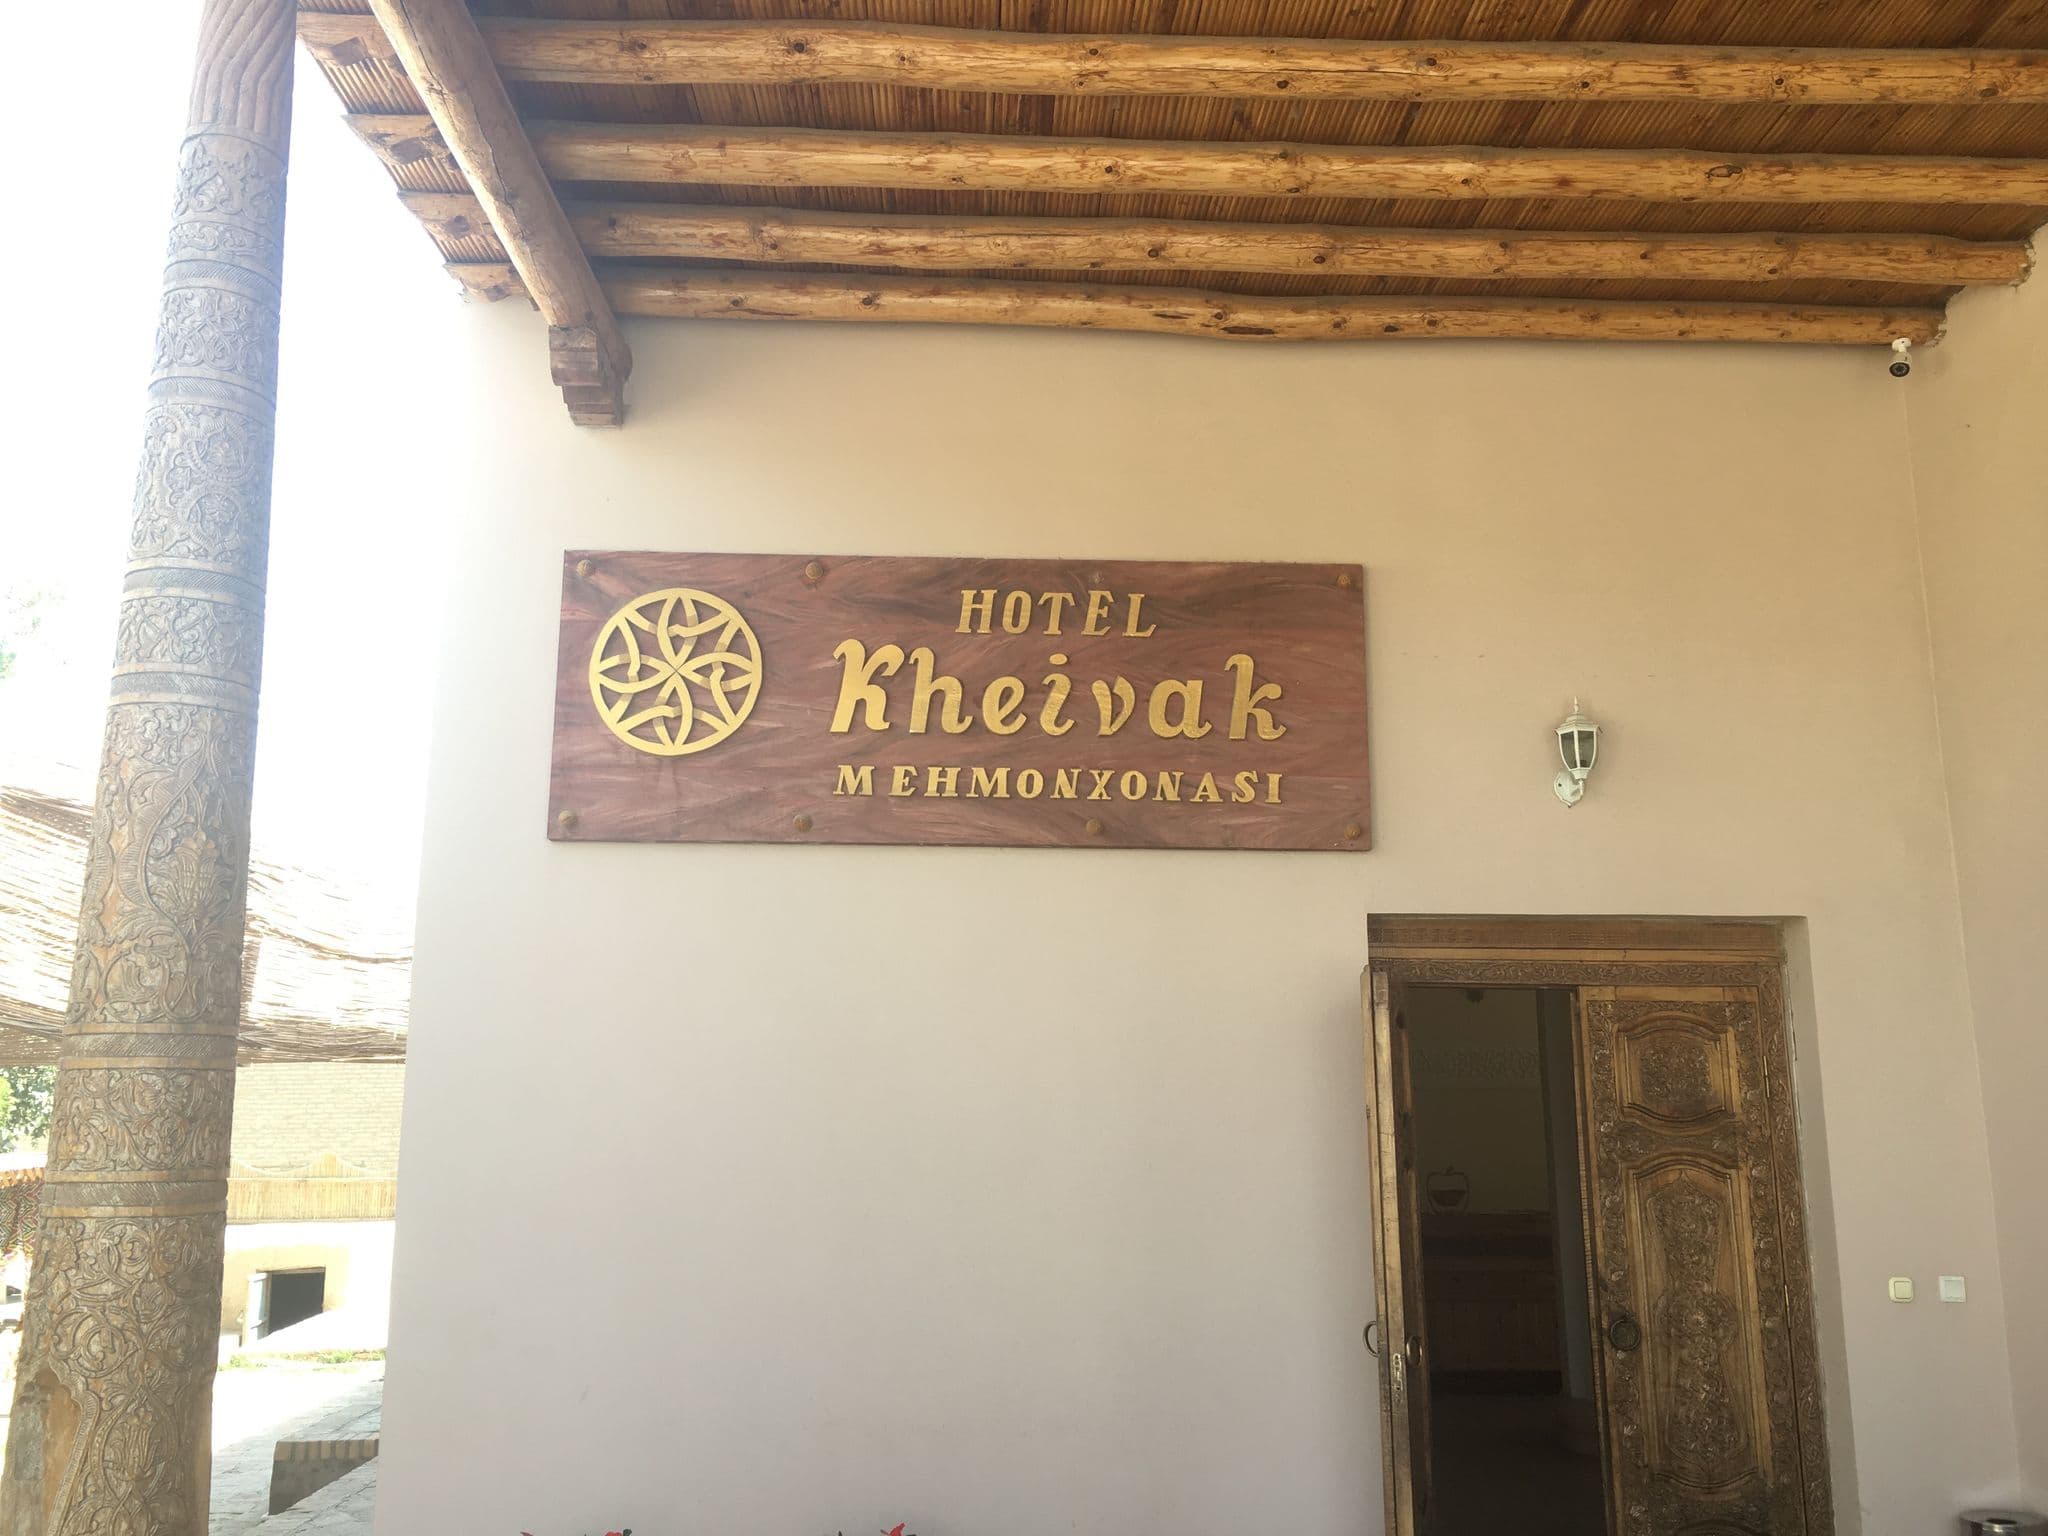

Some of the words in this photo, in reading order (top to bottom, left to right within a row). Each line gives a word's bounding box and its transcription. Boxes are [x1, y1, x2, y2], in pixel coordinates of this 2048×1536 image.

[955, 589, 1157, 637] HOTEL
[830, 638, 1287, 740] Kheivak
[834, 764, 1284, 804] MEHMONXONASI
